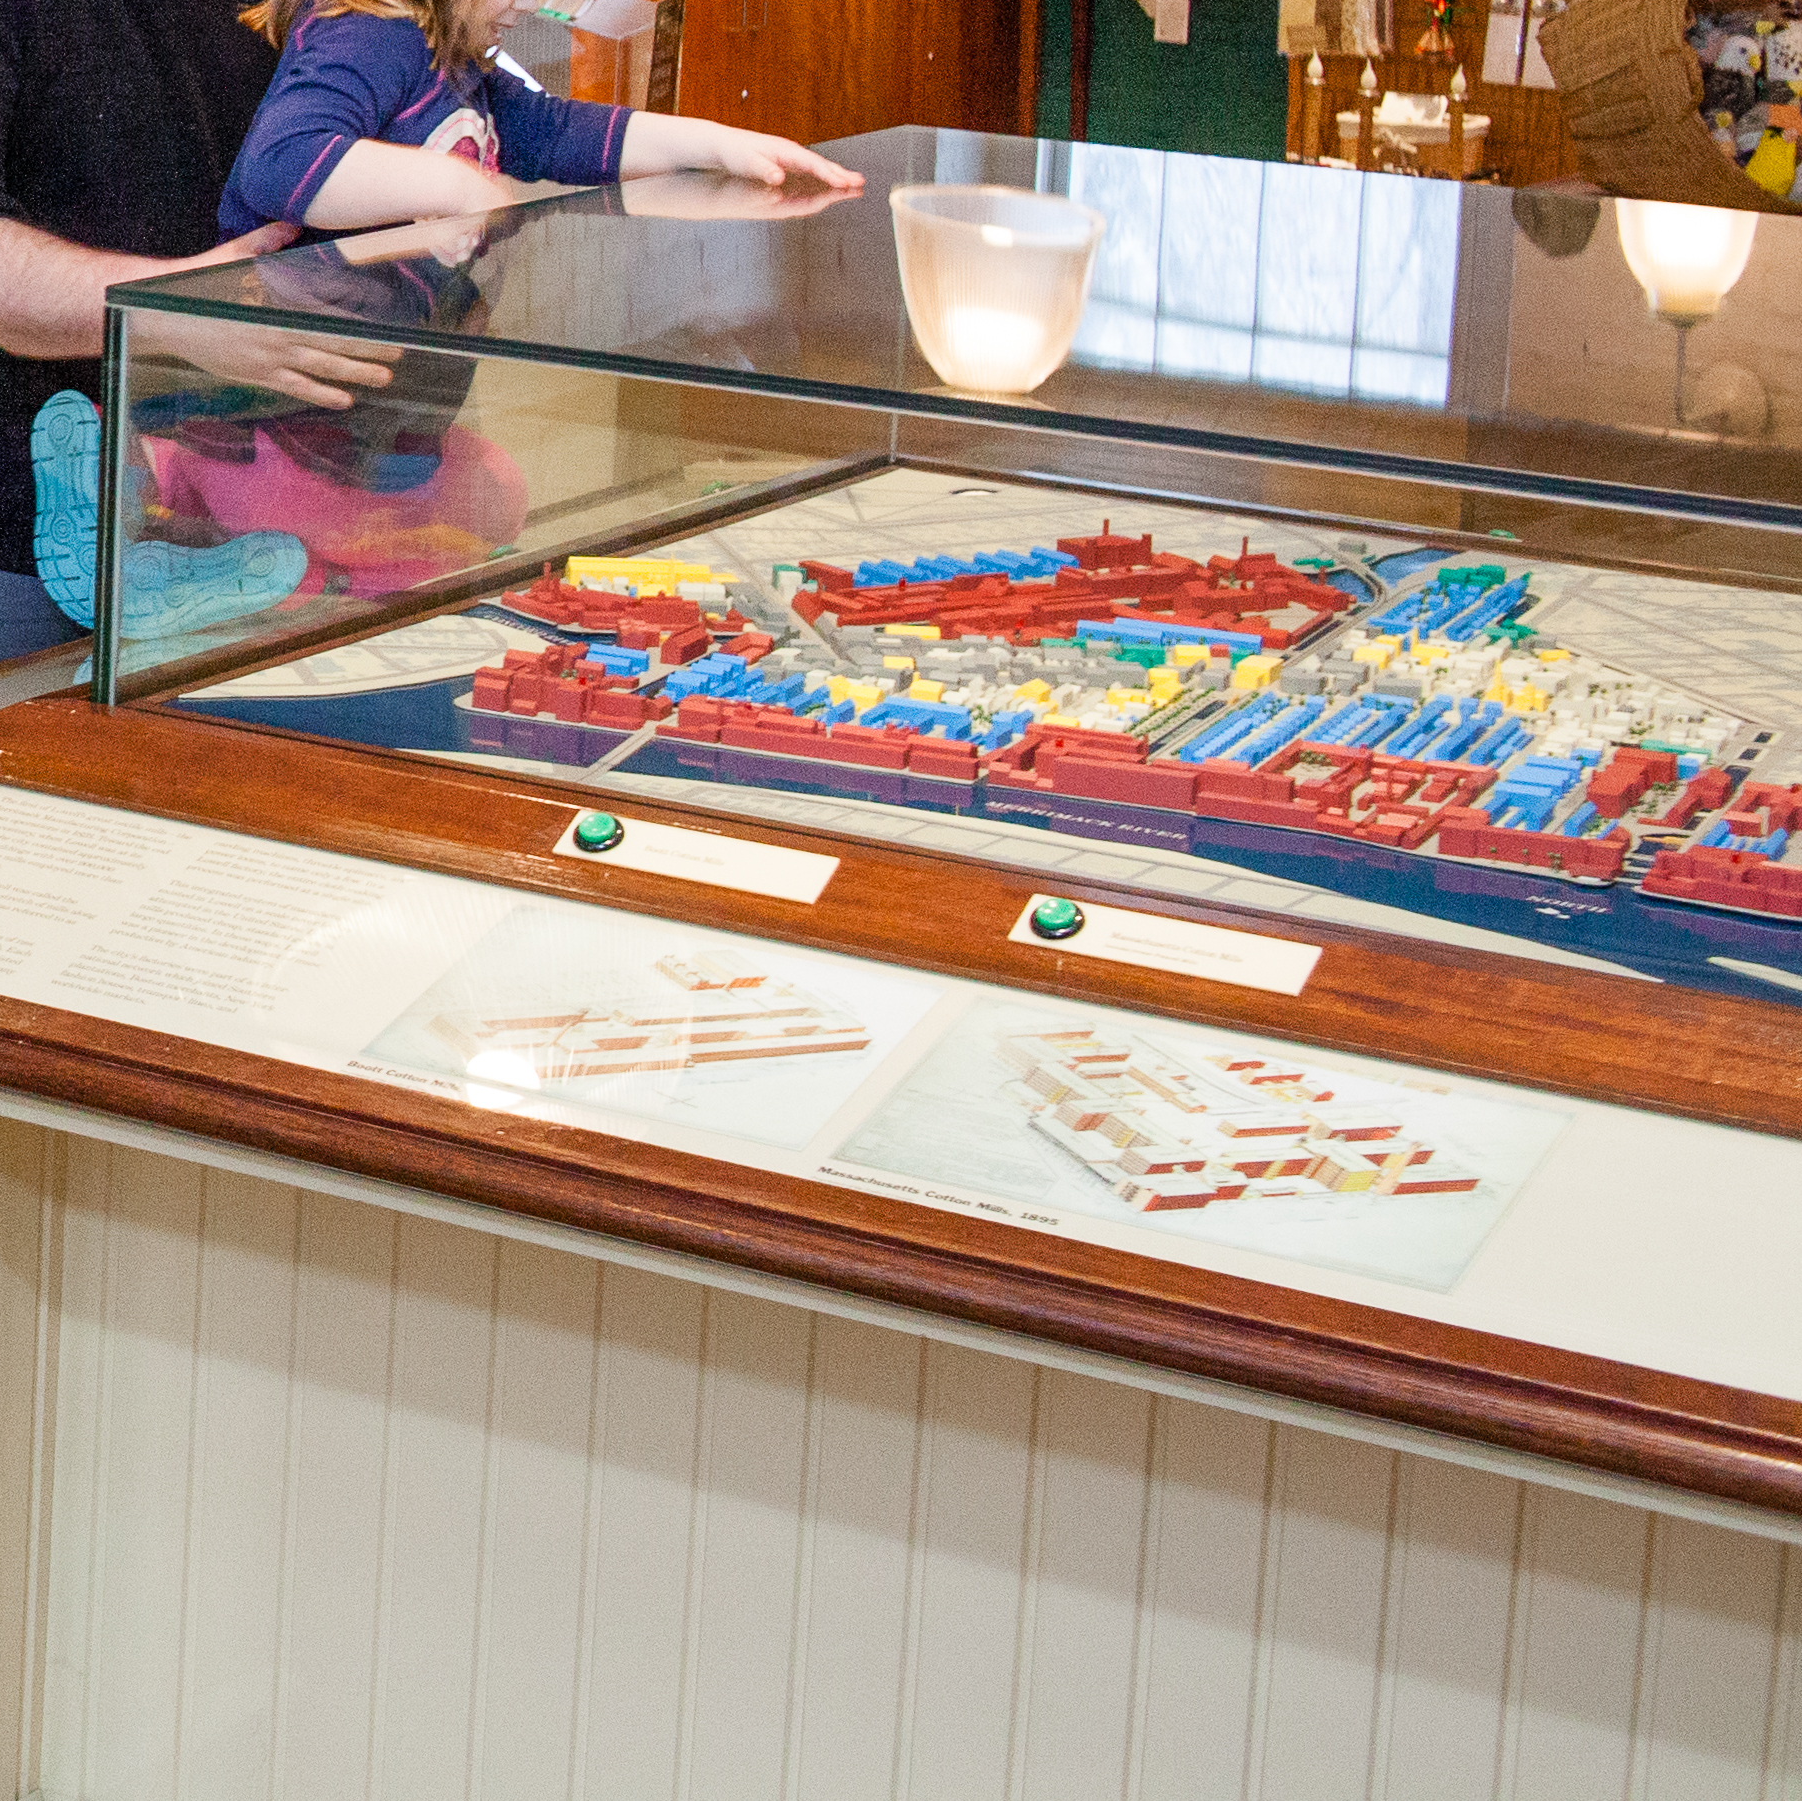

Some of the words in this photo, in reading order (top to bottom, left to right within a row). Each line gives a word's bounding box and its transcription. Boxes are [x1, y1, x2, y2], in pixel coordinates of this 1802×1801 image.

[1117, 824, 1188, 840] RIVER
[347, 1060, 384, 1074] Boott
[386, 1069, 427, 1084] Cotton
[817, 1166, 919, 1194] Massachusetts
[924, 1190, 972, 1207] Cotton
[975, 1201, 1013, 1218] Mills,
[1019, 1212, 1059, 1226] 1895
